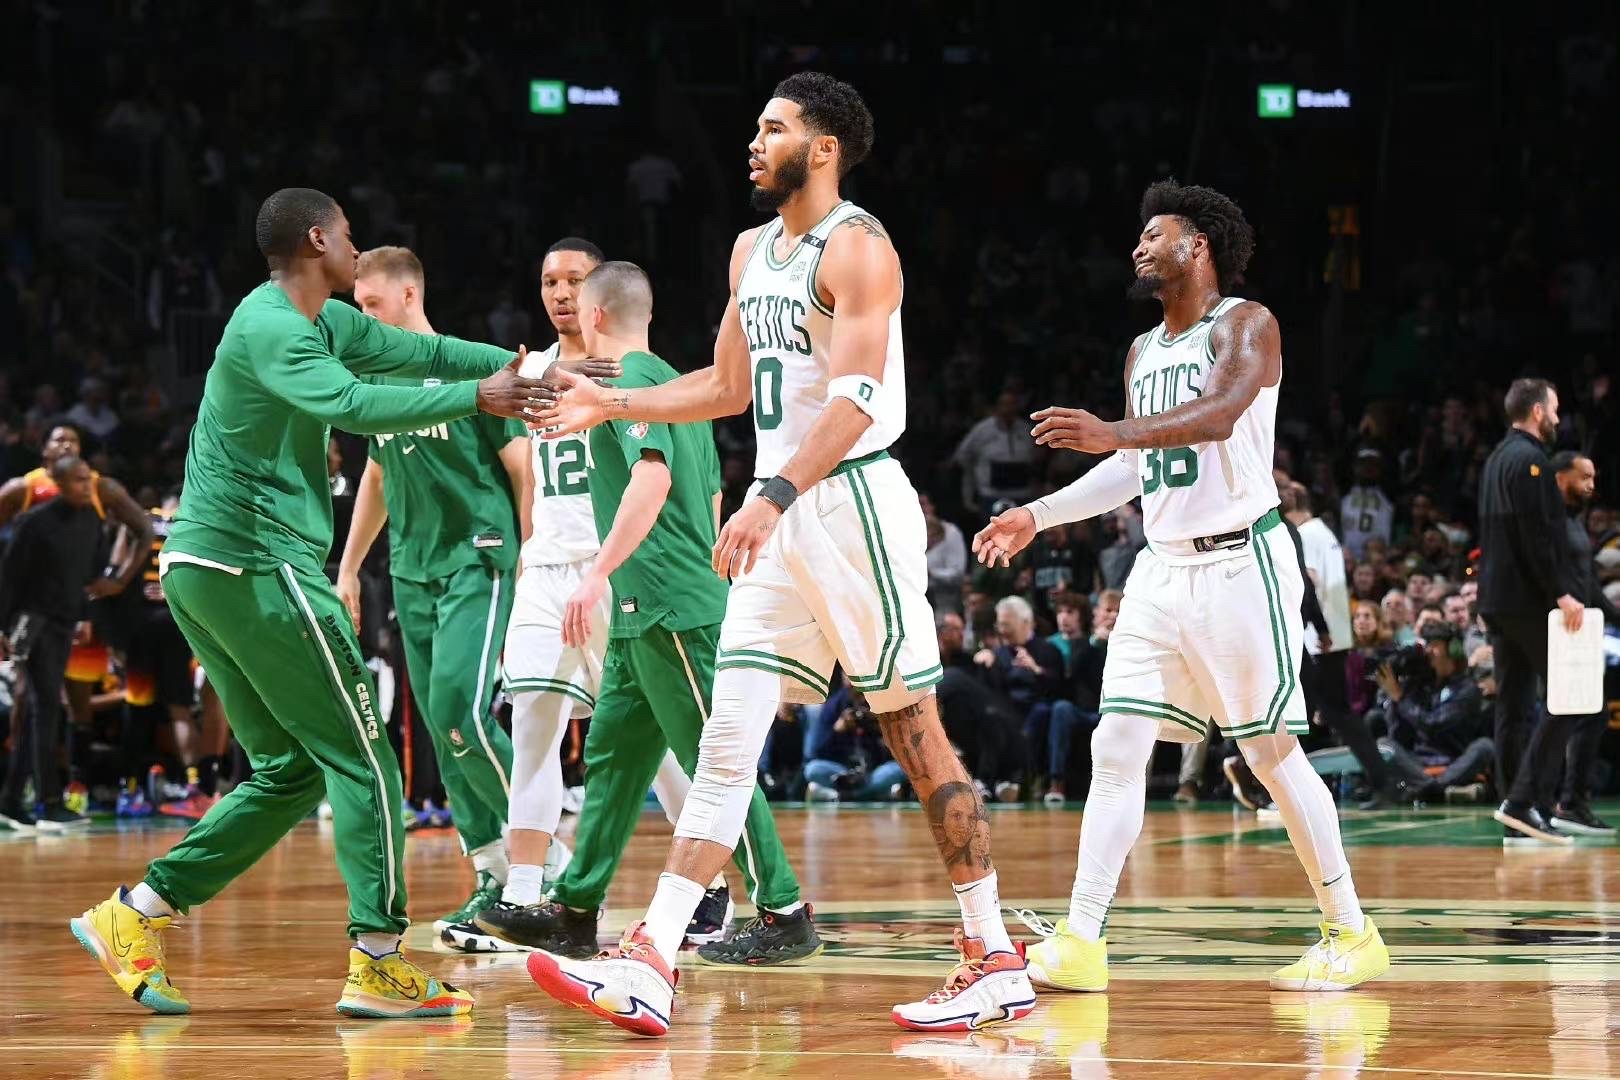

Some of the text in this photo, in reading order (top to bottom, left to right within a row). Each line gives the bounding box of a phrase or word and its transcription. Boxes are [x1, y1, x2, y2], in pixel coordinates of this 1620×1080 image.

[533, 86, 619, 108] TD Bank
[1261, 88, 1350, 113] TD Bank
[755, 357, 783, 430] 0
[538, 439, 590, 497] 12
[1140, 446, 1199, 496] 36
[325, 613, 379, 740] BOSTON CELTICS
